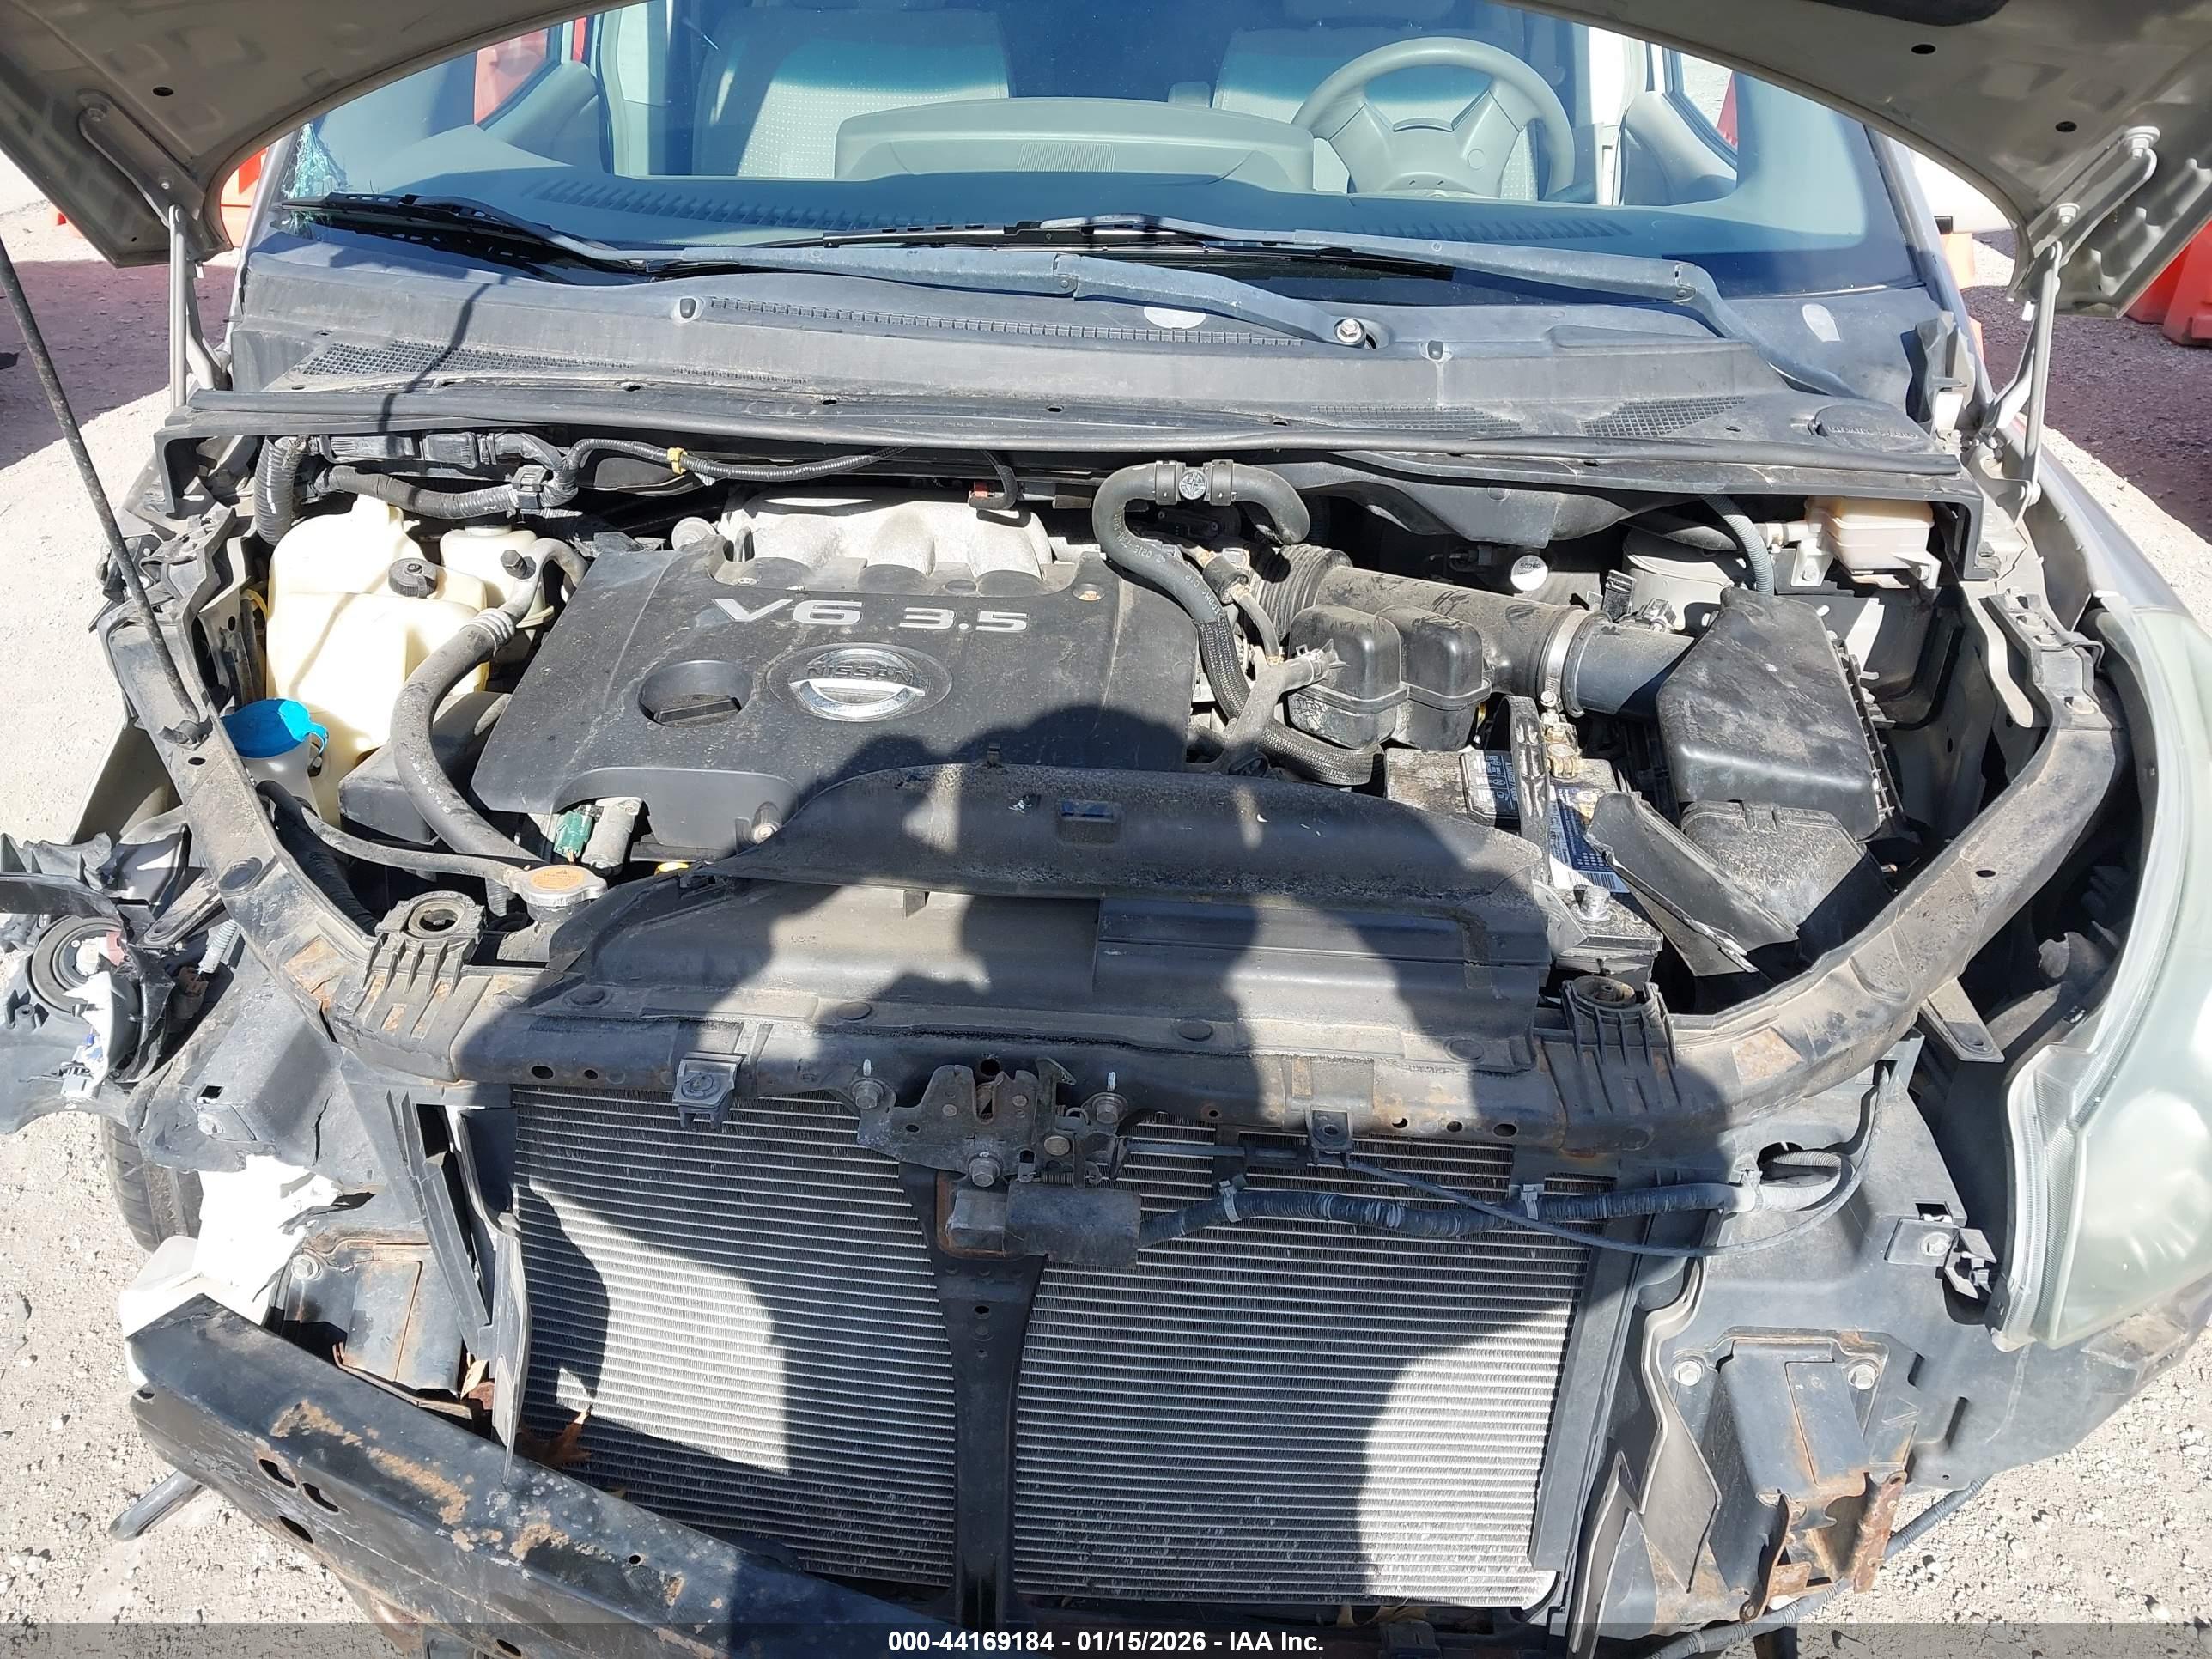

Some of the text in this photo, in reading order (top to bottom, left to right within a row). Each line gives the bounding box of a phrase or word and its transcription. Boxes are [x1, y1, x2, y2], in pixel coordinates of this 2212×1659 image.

[714, 598, 1029, 632] V6 3.5
[806, 665, 915, 685] NISSAN
